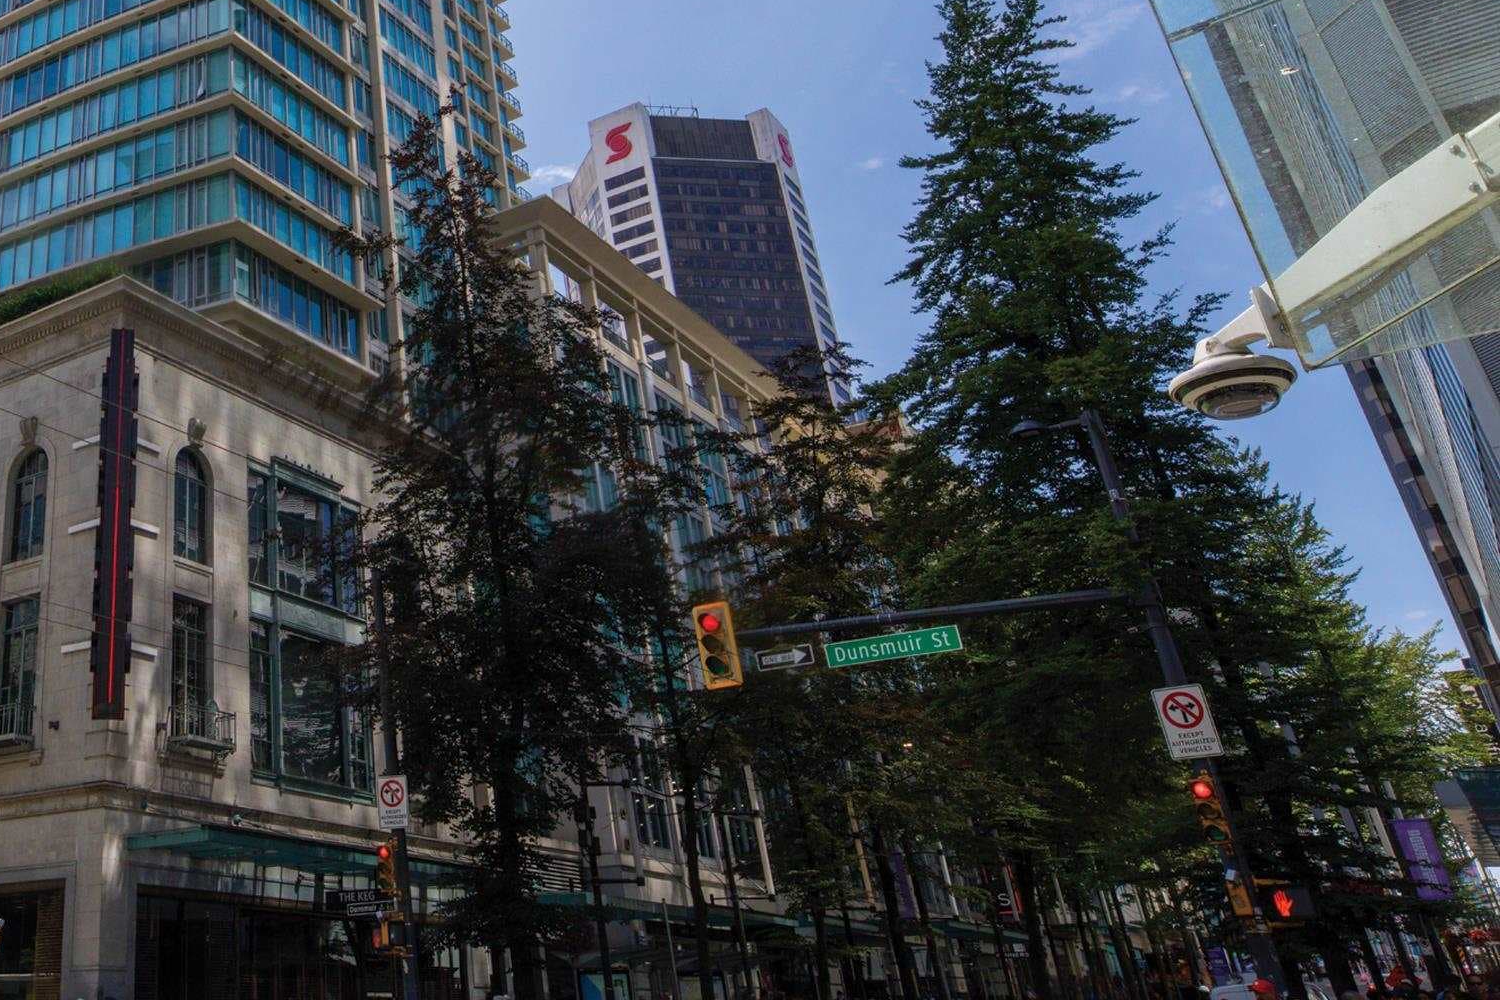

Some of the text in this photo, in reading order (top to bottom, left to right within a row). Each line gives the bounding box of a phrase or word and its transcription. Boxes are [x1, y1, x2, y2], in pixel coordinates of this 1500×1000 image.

[835, 631, 951, 663] Dunsmuir St
[1178, 731, 1204, 739] EXCEPT
[1180, 745, 1213, 754] VEHICLES
[339, 891, 376, 902] THE KEG
